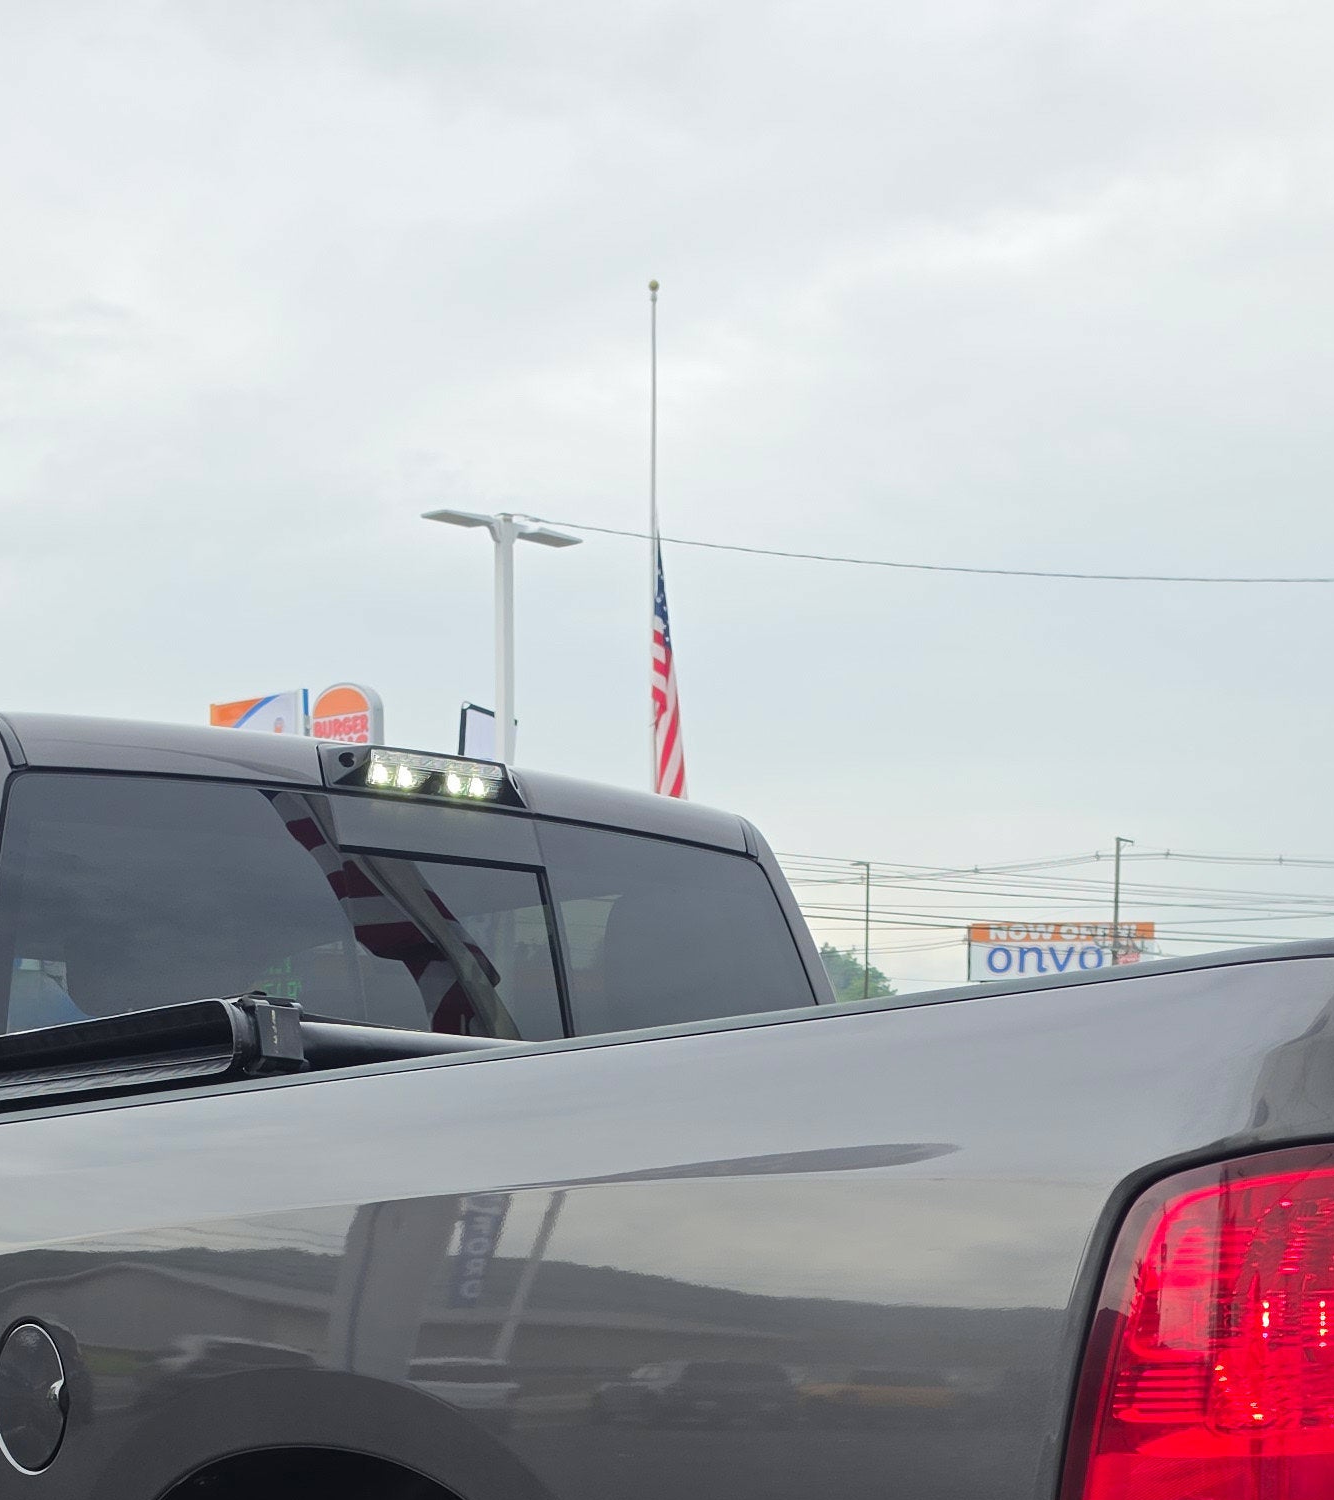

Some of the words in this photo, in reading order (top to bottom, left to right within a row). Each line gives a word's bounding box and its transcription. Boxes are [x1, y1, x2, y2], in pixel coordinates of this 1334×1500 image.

[314, 714, 368, 738] BURGER
[988, 924, 1055, 941] NOW
[987, 946, 1103, 973] onvo
